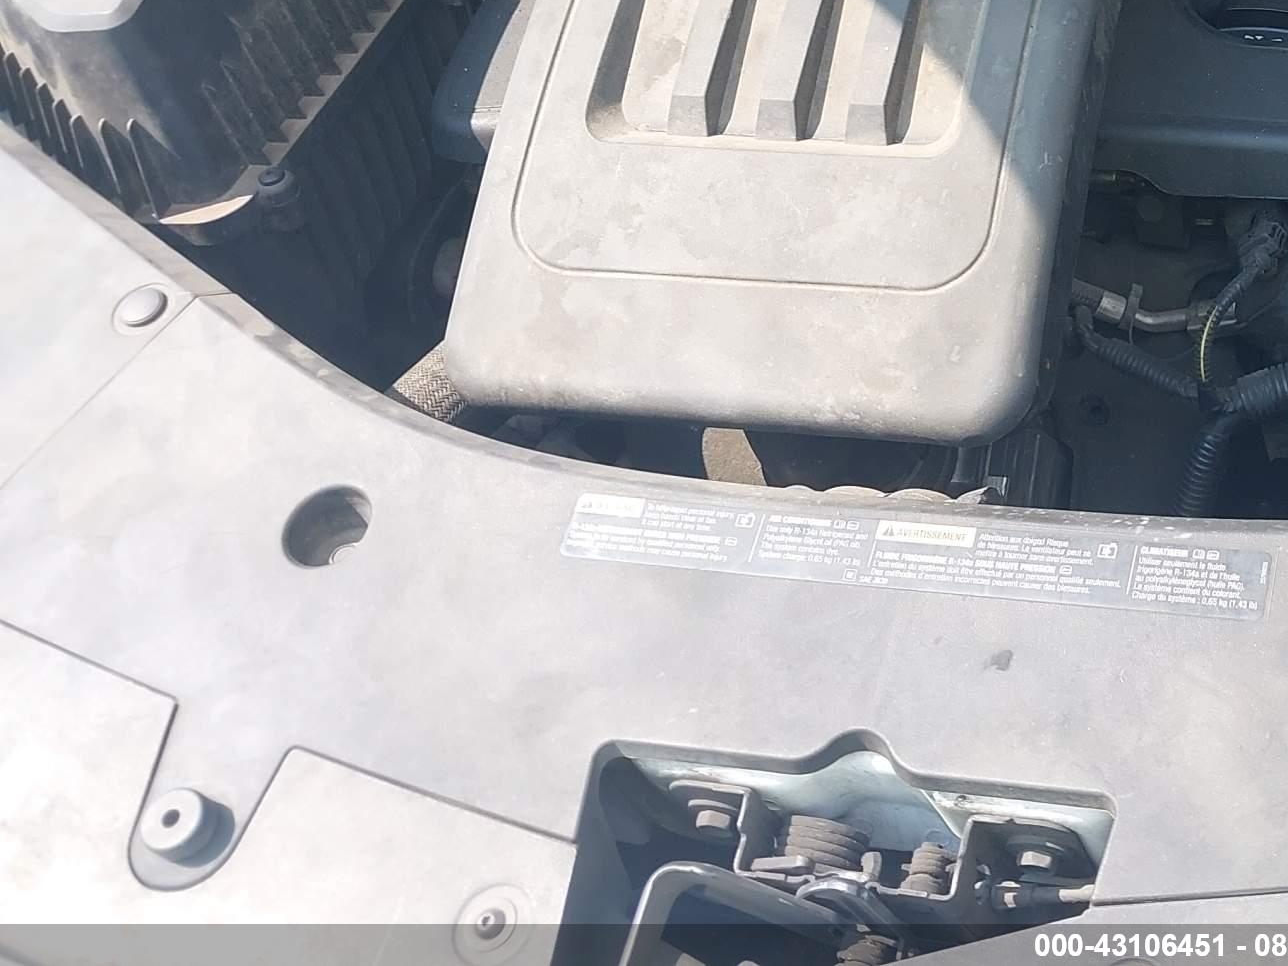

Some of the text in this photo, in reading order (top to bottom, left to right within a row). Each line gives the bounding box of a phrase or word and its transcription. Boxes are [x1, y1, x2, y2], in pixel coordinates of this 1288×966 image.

[897, 528, 968, 541] AVERTISSEMENT
[1134, 582, 1141, 590] Le
[1202, 589, 1210, 597] du
[1132, 591, 1156, 601] Charge
[1157, 593, 1165, 602] du
[1219, 600, 1227, 608] kg
